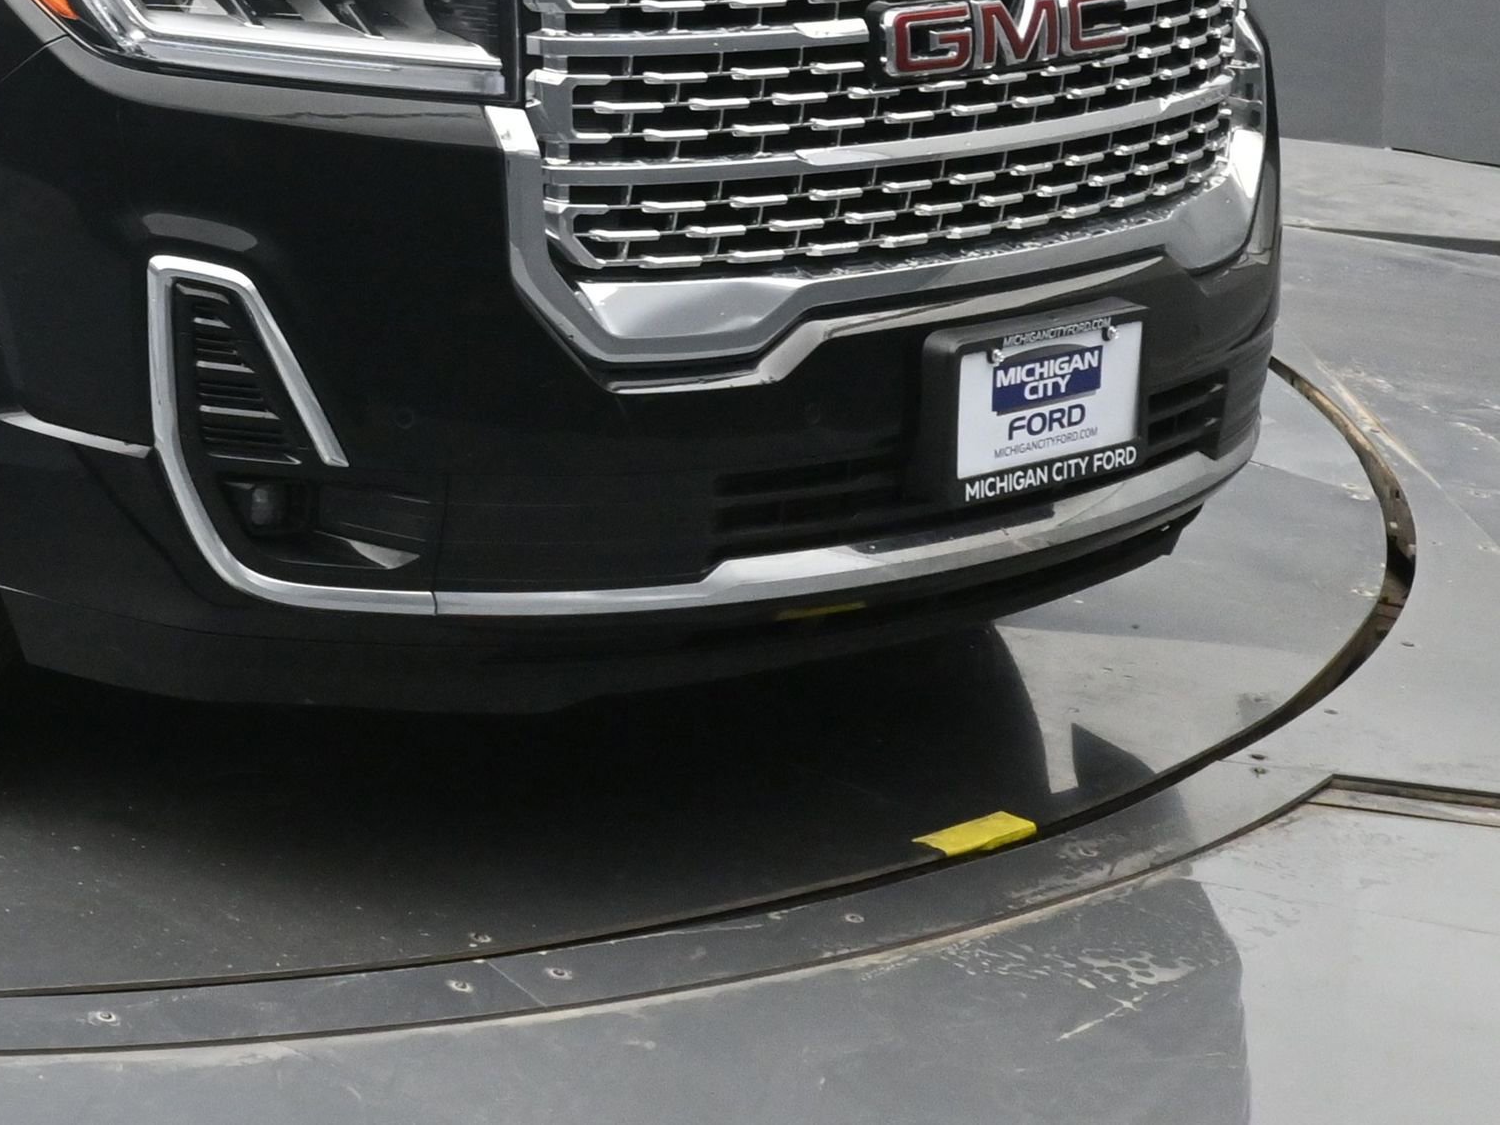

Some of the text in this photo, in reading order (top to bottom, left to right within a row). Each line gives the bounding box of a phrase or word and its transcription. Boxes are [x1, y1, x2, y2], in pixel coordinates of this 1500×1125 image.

[1003, 317, 1112, 347] MICHIGANCITYFORD.COM
[995, 349, 1100, 389] MICHIGAN
[1023, 375, 1071, 401] CITY
[1007, 403, 1086, 441] FORD
[993, 426, 1098, 459] MICHIGANCITYFORD.COM
[965, 445, 1137, 502] MICHIGAN CITY FORD
